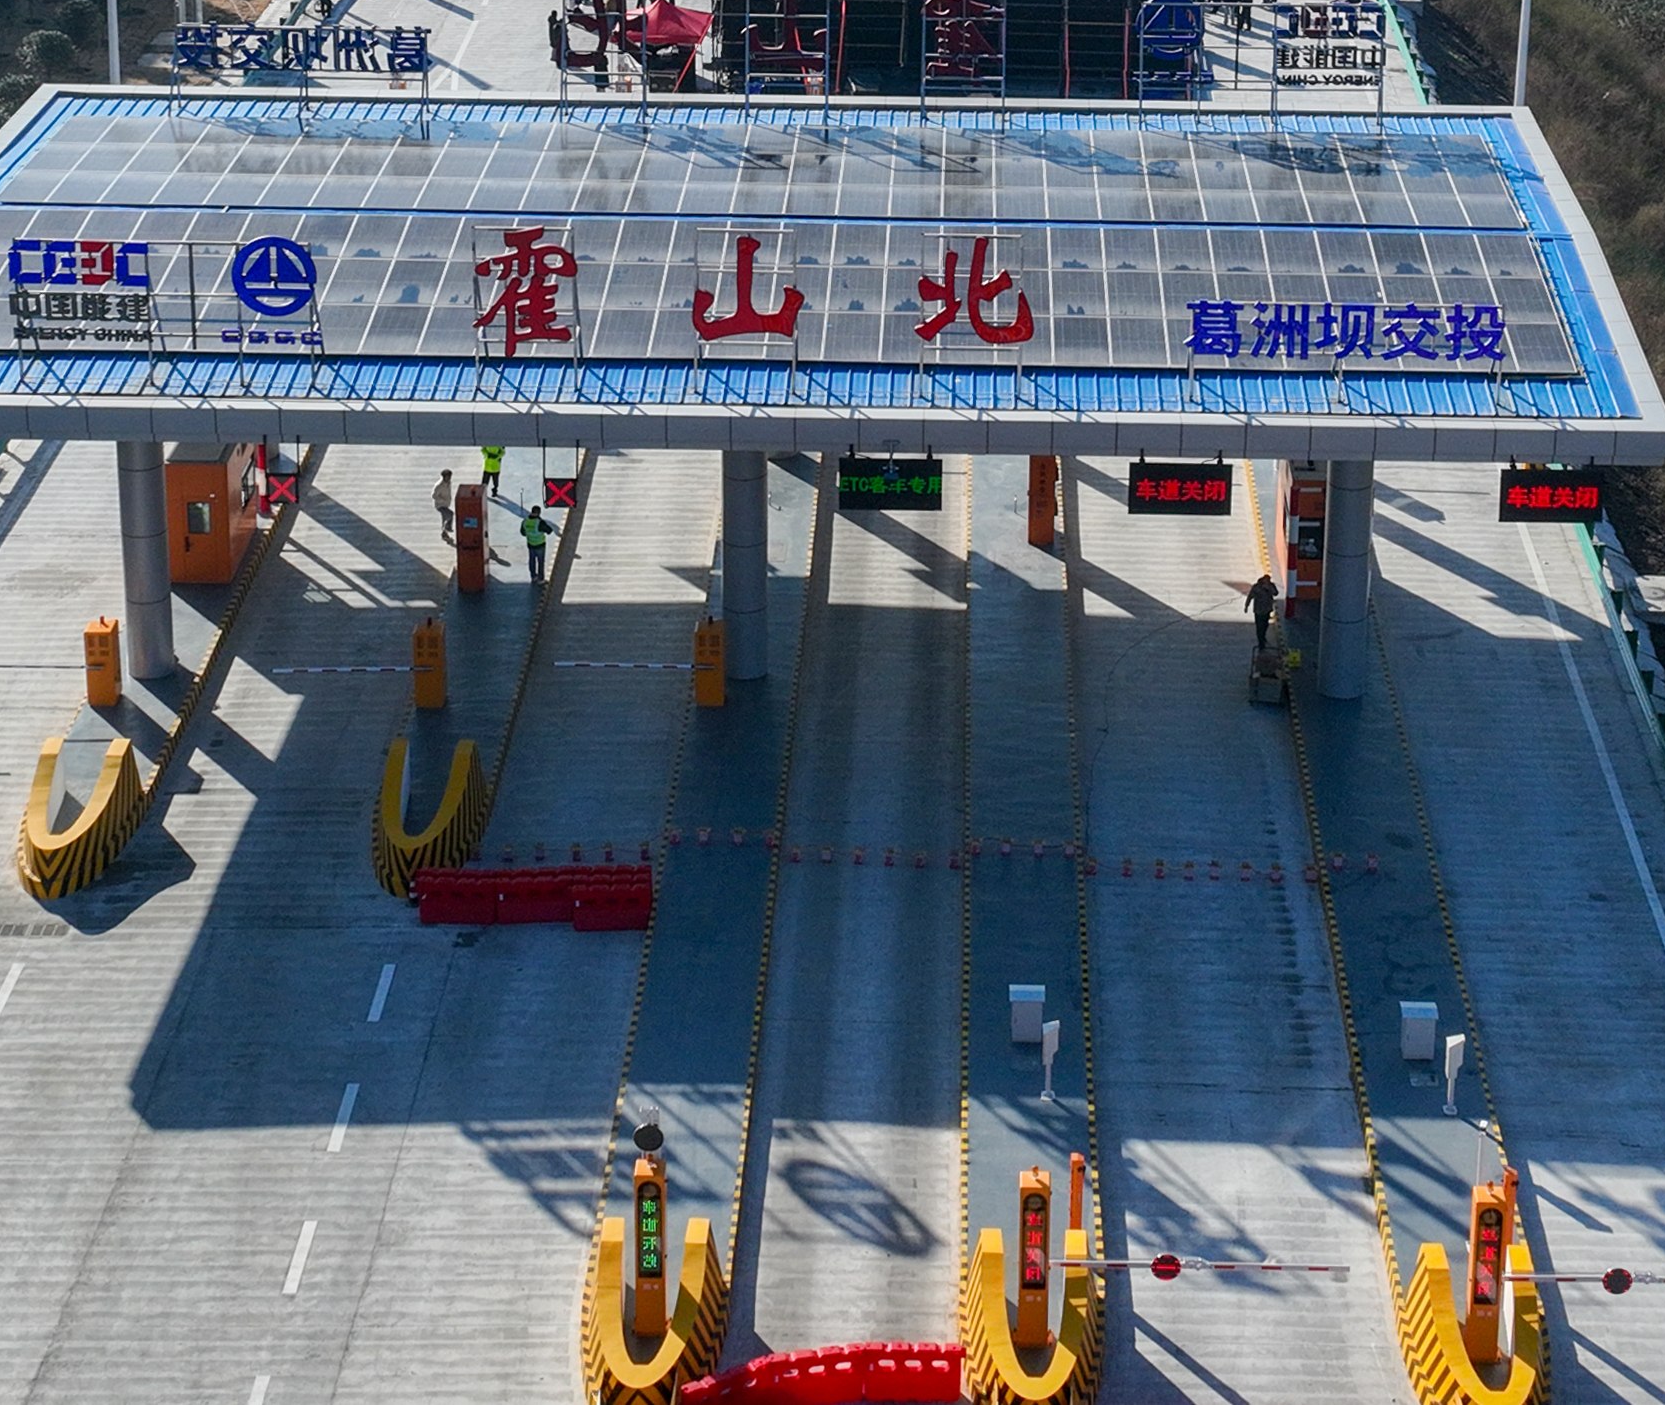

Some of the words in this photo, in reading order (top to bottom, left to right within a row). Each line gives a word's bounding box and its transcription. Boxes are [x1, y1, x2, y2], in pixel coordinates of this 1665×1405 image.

[474, 225, 1034, 356] 霍山北
[8, 292, 151, 323] 中国能建
[13, 326, 89, 342] ENERGY
[93, 327, 154, 343] CHINA
[1185, 300, 1507, 362] 葛洲坝交投
[1135, 478, 1227, 503] 车道关闭
[1505, 485, 1599, 510] 车道关闭
